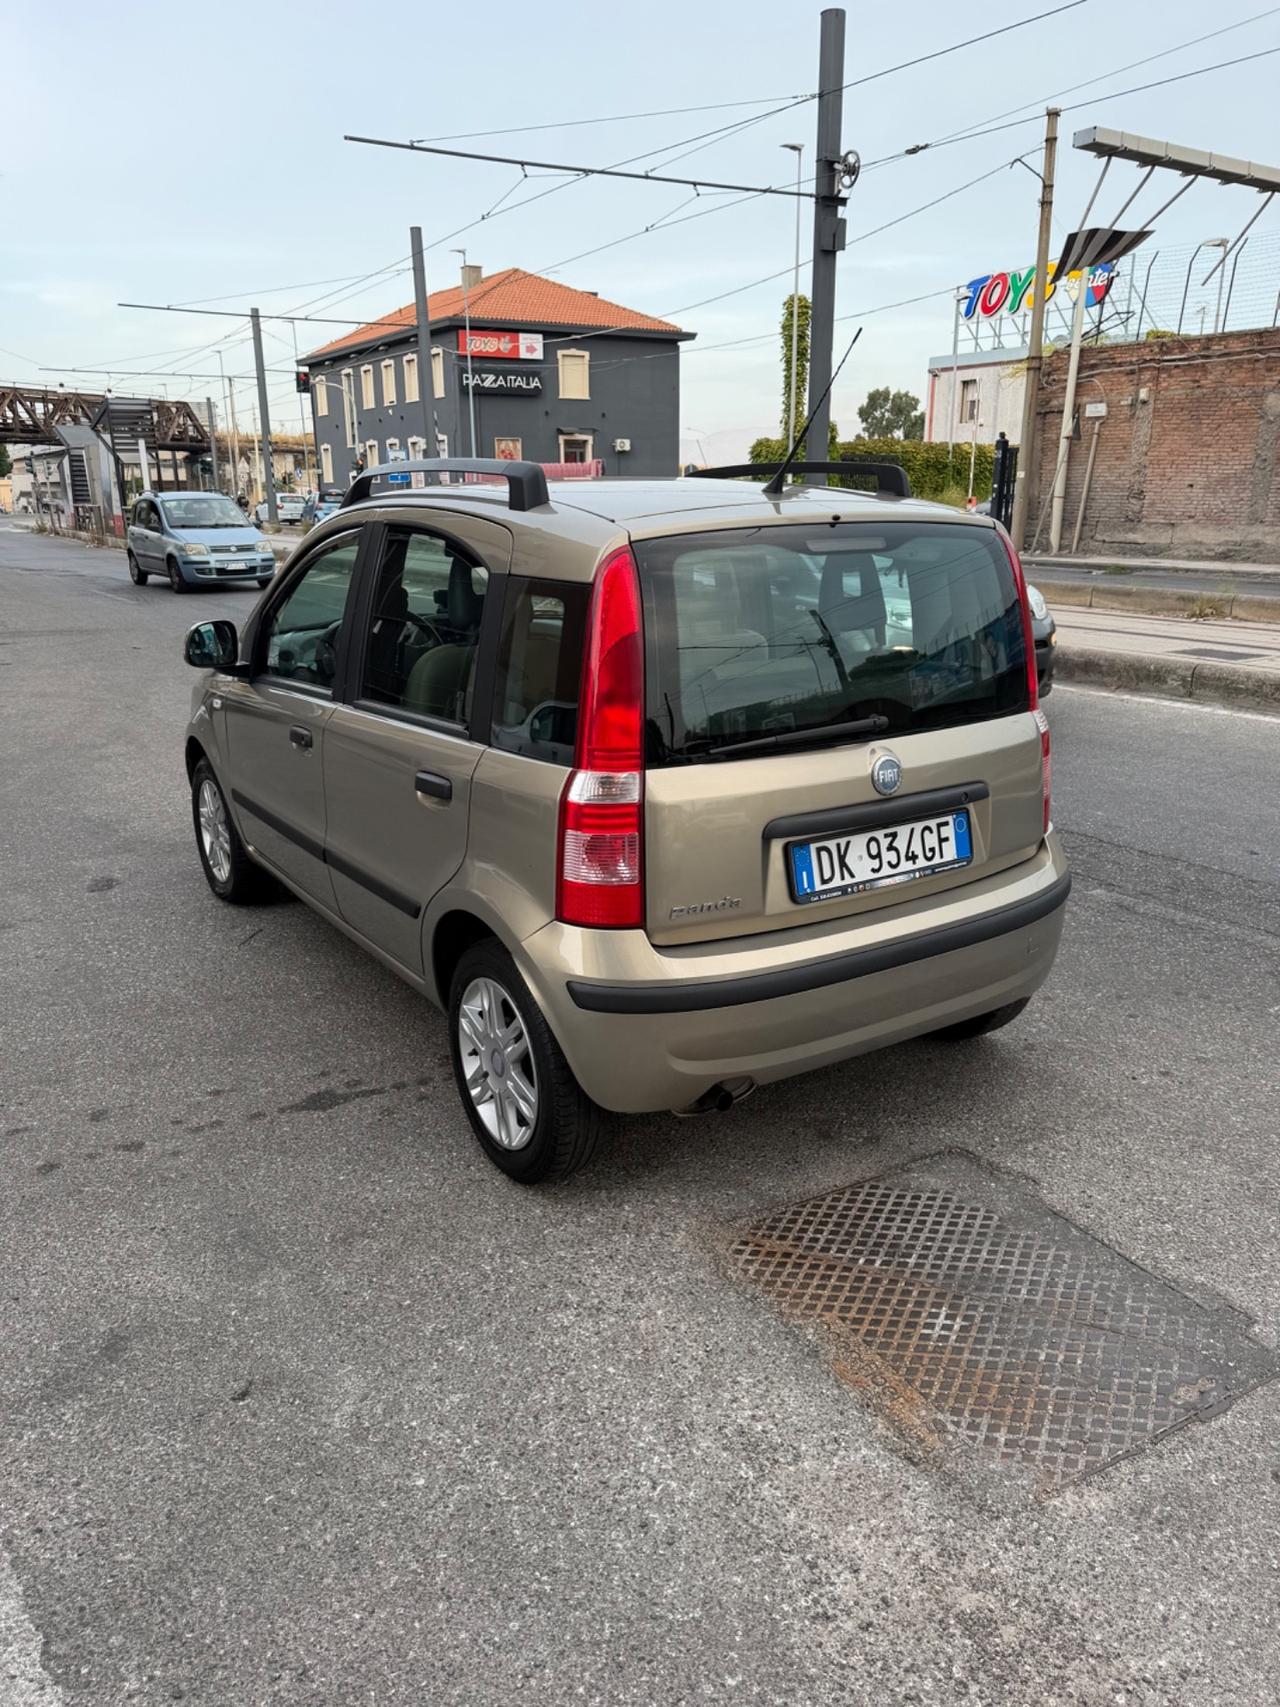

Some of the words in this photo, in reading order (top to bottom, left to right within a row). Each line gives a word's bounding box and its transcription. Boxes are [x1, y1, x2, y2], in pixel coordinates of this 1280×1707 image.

[466, 336, 498, 352] TOYS
[507, 375, 542, 389] ITALIA
[879, 769, 899, 783] FIAT
[815, 840, 856, 886] DK
[865, 821, 951, 874] 934GF
[668, 896, 742, 920] panda
